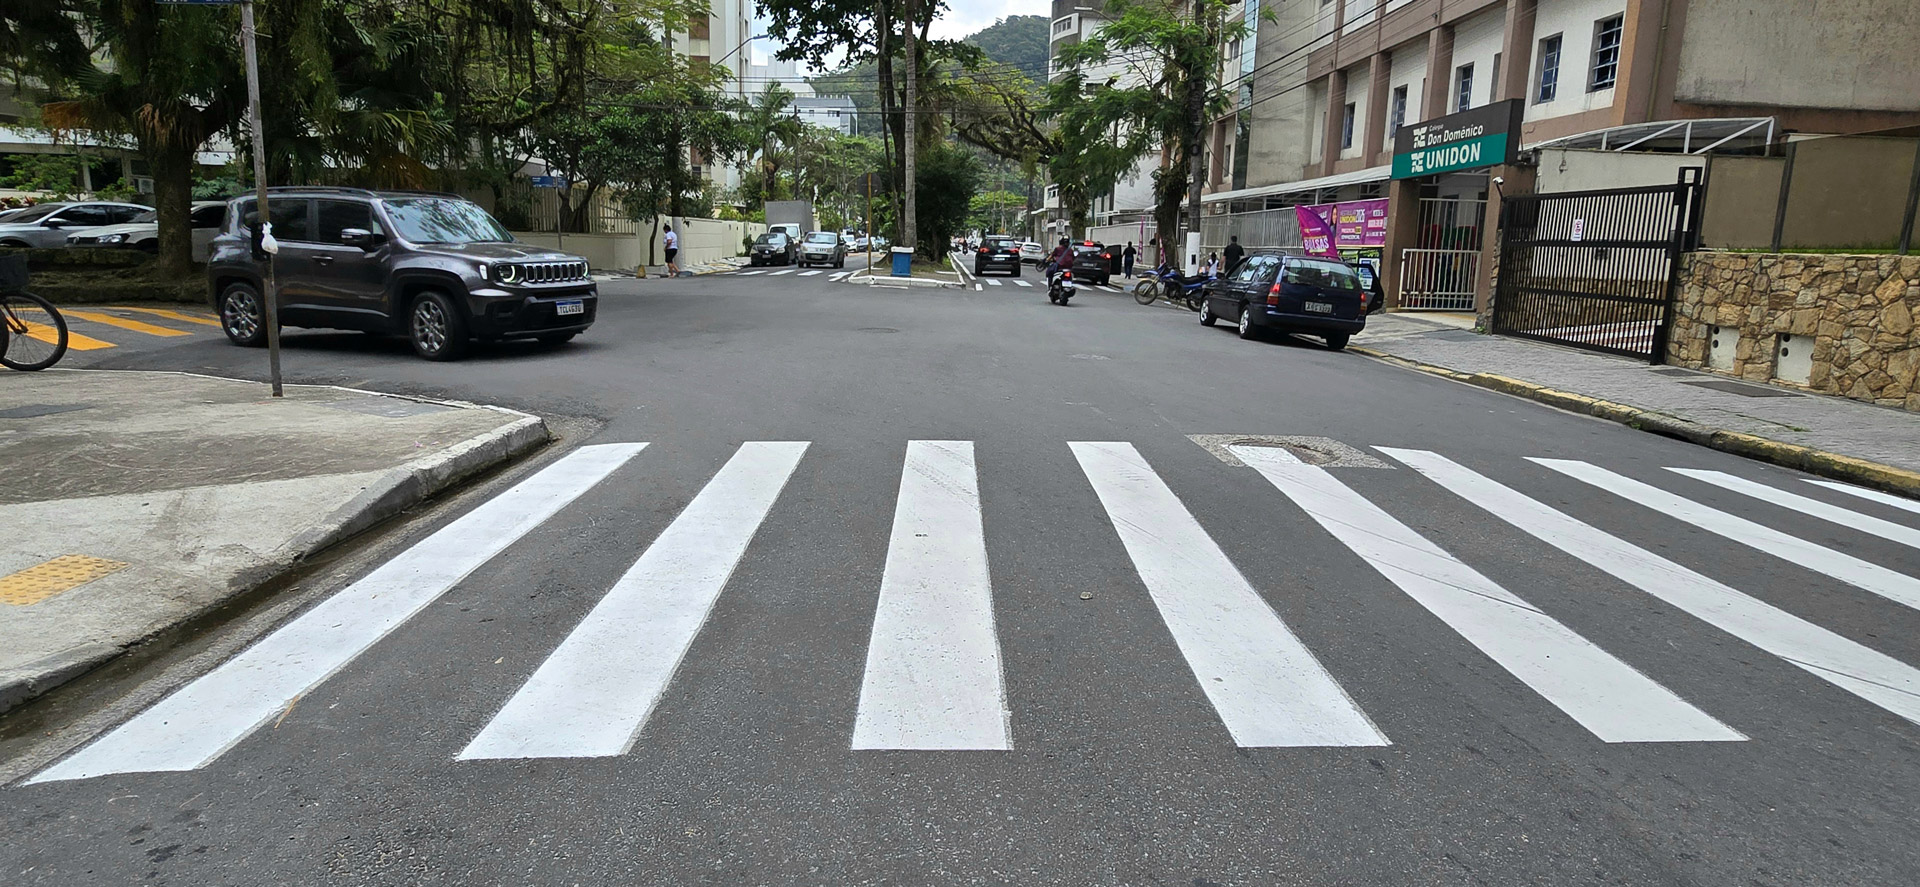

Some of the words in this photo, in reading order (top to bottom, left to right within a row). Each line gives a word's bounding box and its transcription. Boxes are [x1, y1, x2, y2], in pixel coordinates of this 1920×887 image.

[1427, 133, 1442, 146] Don
[1426, 142, 1481, 169] UNIDON
[1304, 237, 1330, 250] BOLSAS
